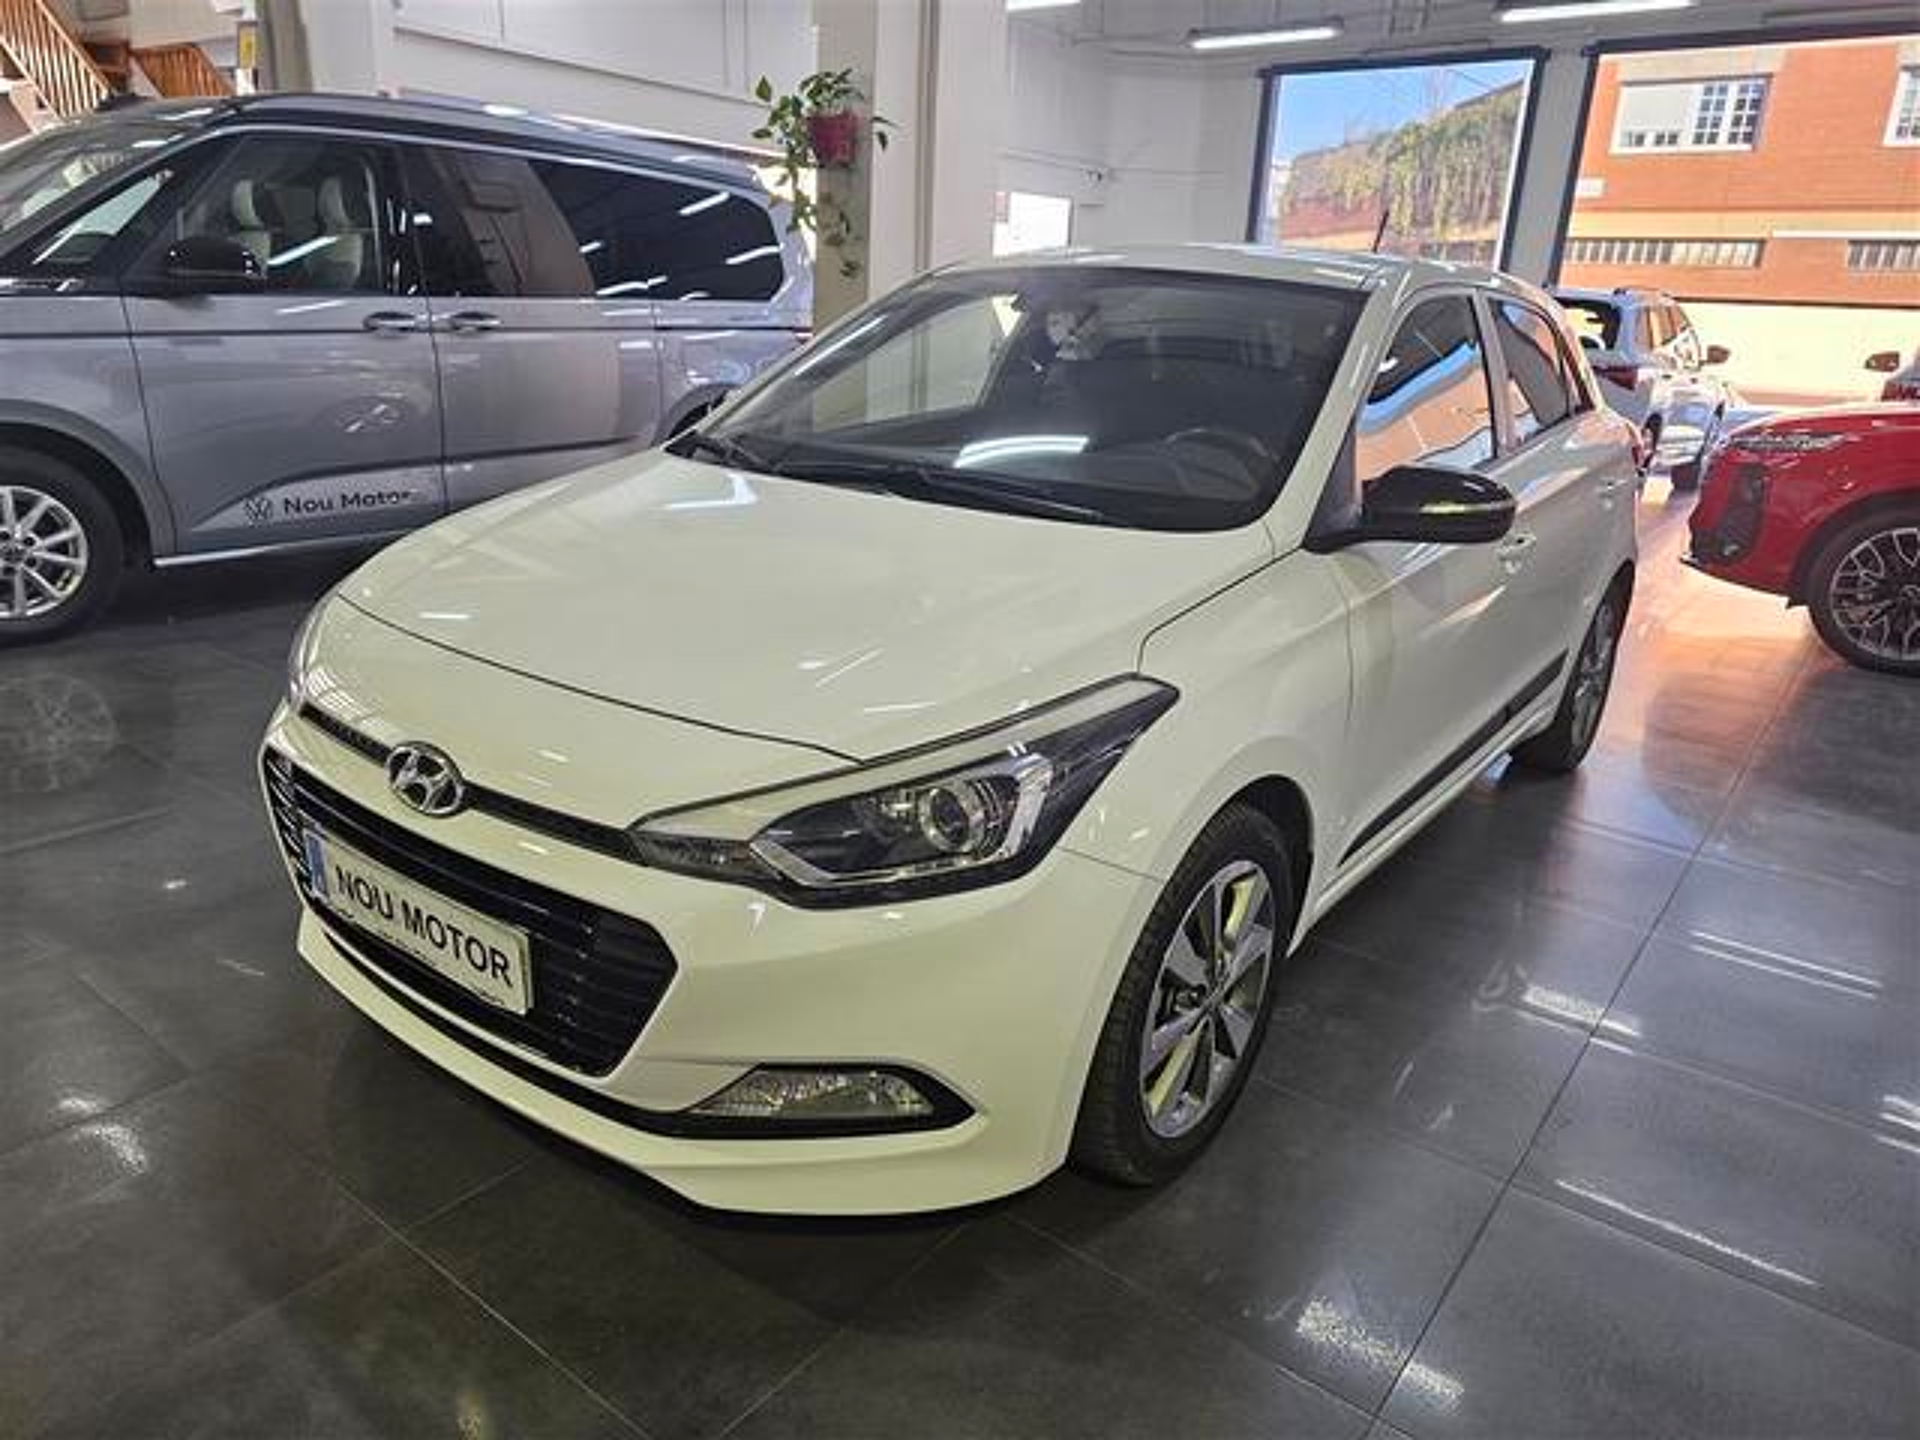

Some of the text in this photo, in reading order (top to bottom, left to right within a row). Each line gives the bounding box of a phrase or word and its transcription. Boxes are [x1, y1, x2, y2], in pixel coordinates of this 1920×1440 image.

[284, 497, 334, 514] Nou
[341, 491, 411, 509] Motor
[335, 864, 394, 920] NOU
[401, 899, 513, 988] MOTOR
